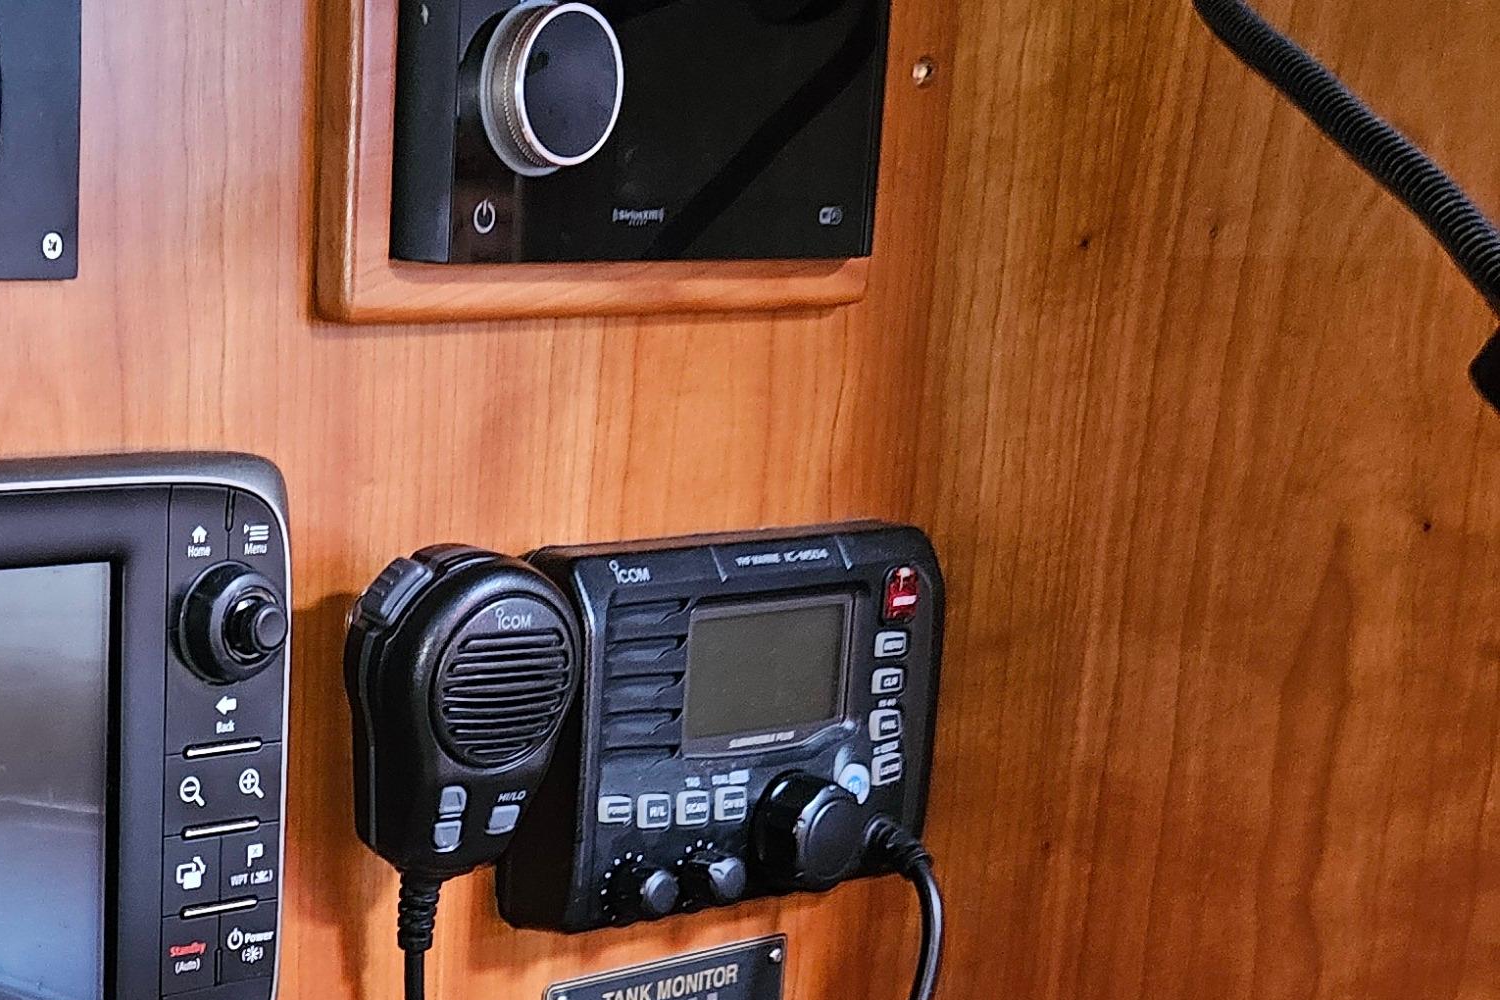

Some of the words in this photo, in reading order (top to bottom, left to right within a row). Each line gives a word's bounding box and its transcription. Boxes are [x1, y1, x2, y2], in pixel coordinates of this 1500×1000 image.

[187, 545, 211, 558] Home
[244, 542, 268, 555] Menu
[216, 720, 236, 734] Back
[244, 931, 274, 944] Power
[656, 963, 739, 1000] MONITOR
